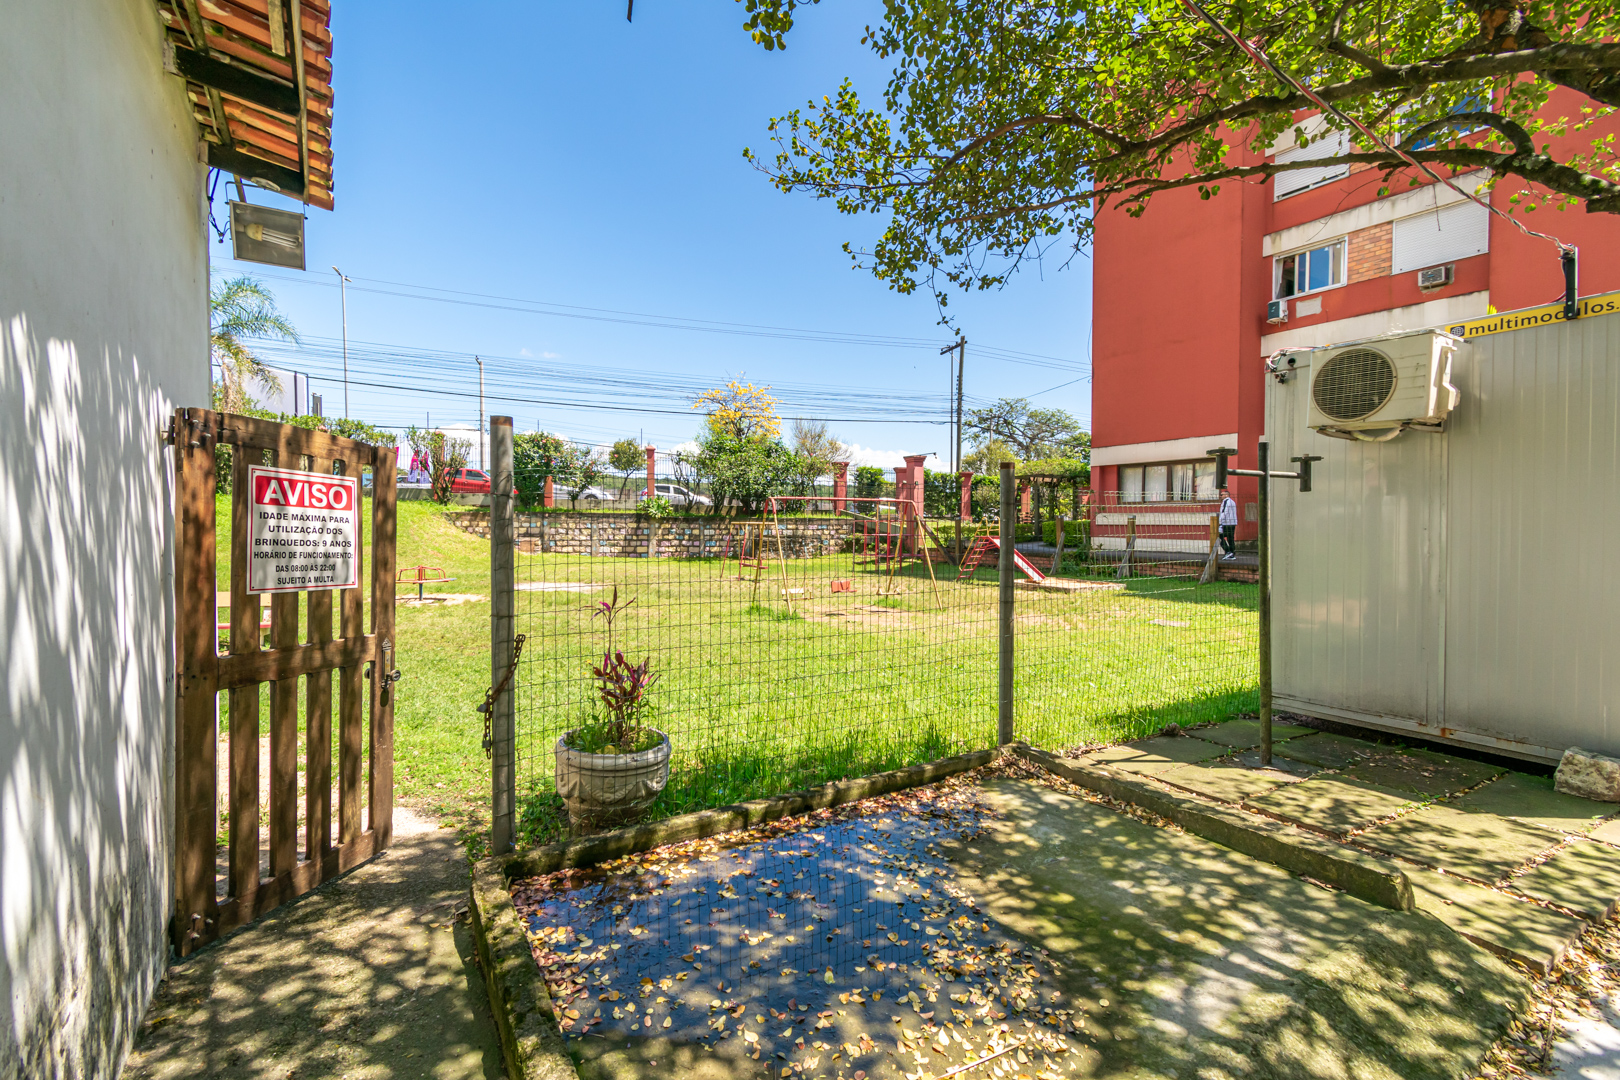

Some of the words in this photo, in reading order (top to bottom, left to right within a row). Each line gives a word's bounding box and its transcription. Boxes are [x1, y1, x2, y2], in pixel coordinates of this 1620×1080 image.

[262, 479, 348, 509] AVISO
[259, 512, 289, 521] IDADE
[291, 512, 327, 523] MÁXIMA
[329, 516, 350, 524] PARA
[268, 525, 324, 535] UTILIZAÇÃO
[255, 538, 320, 547] BRINQUEDOS:
[329, 540, 352, 548] ANOS
[253, 549, 287, 559] HORÁRIO
[288, 551, 298, 559] DE
[299, 551, 354, 559] FUNCIONAMENTO:
[275, 564, 289, 573] DAS
[290, 564, 309, 572] 08:00
[277, 576, 306, 585] SUJEITO
[307, 576, 312, 584] A
[313, 575, 334, 583] MULTA
